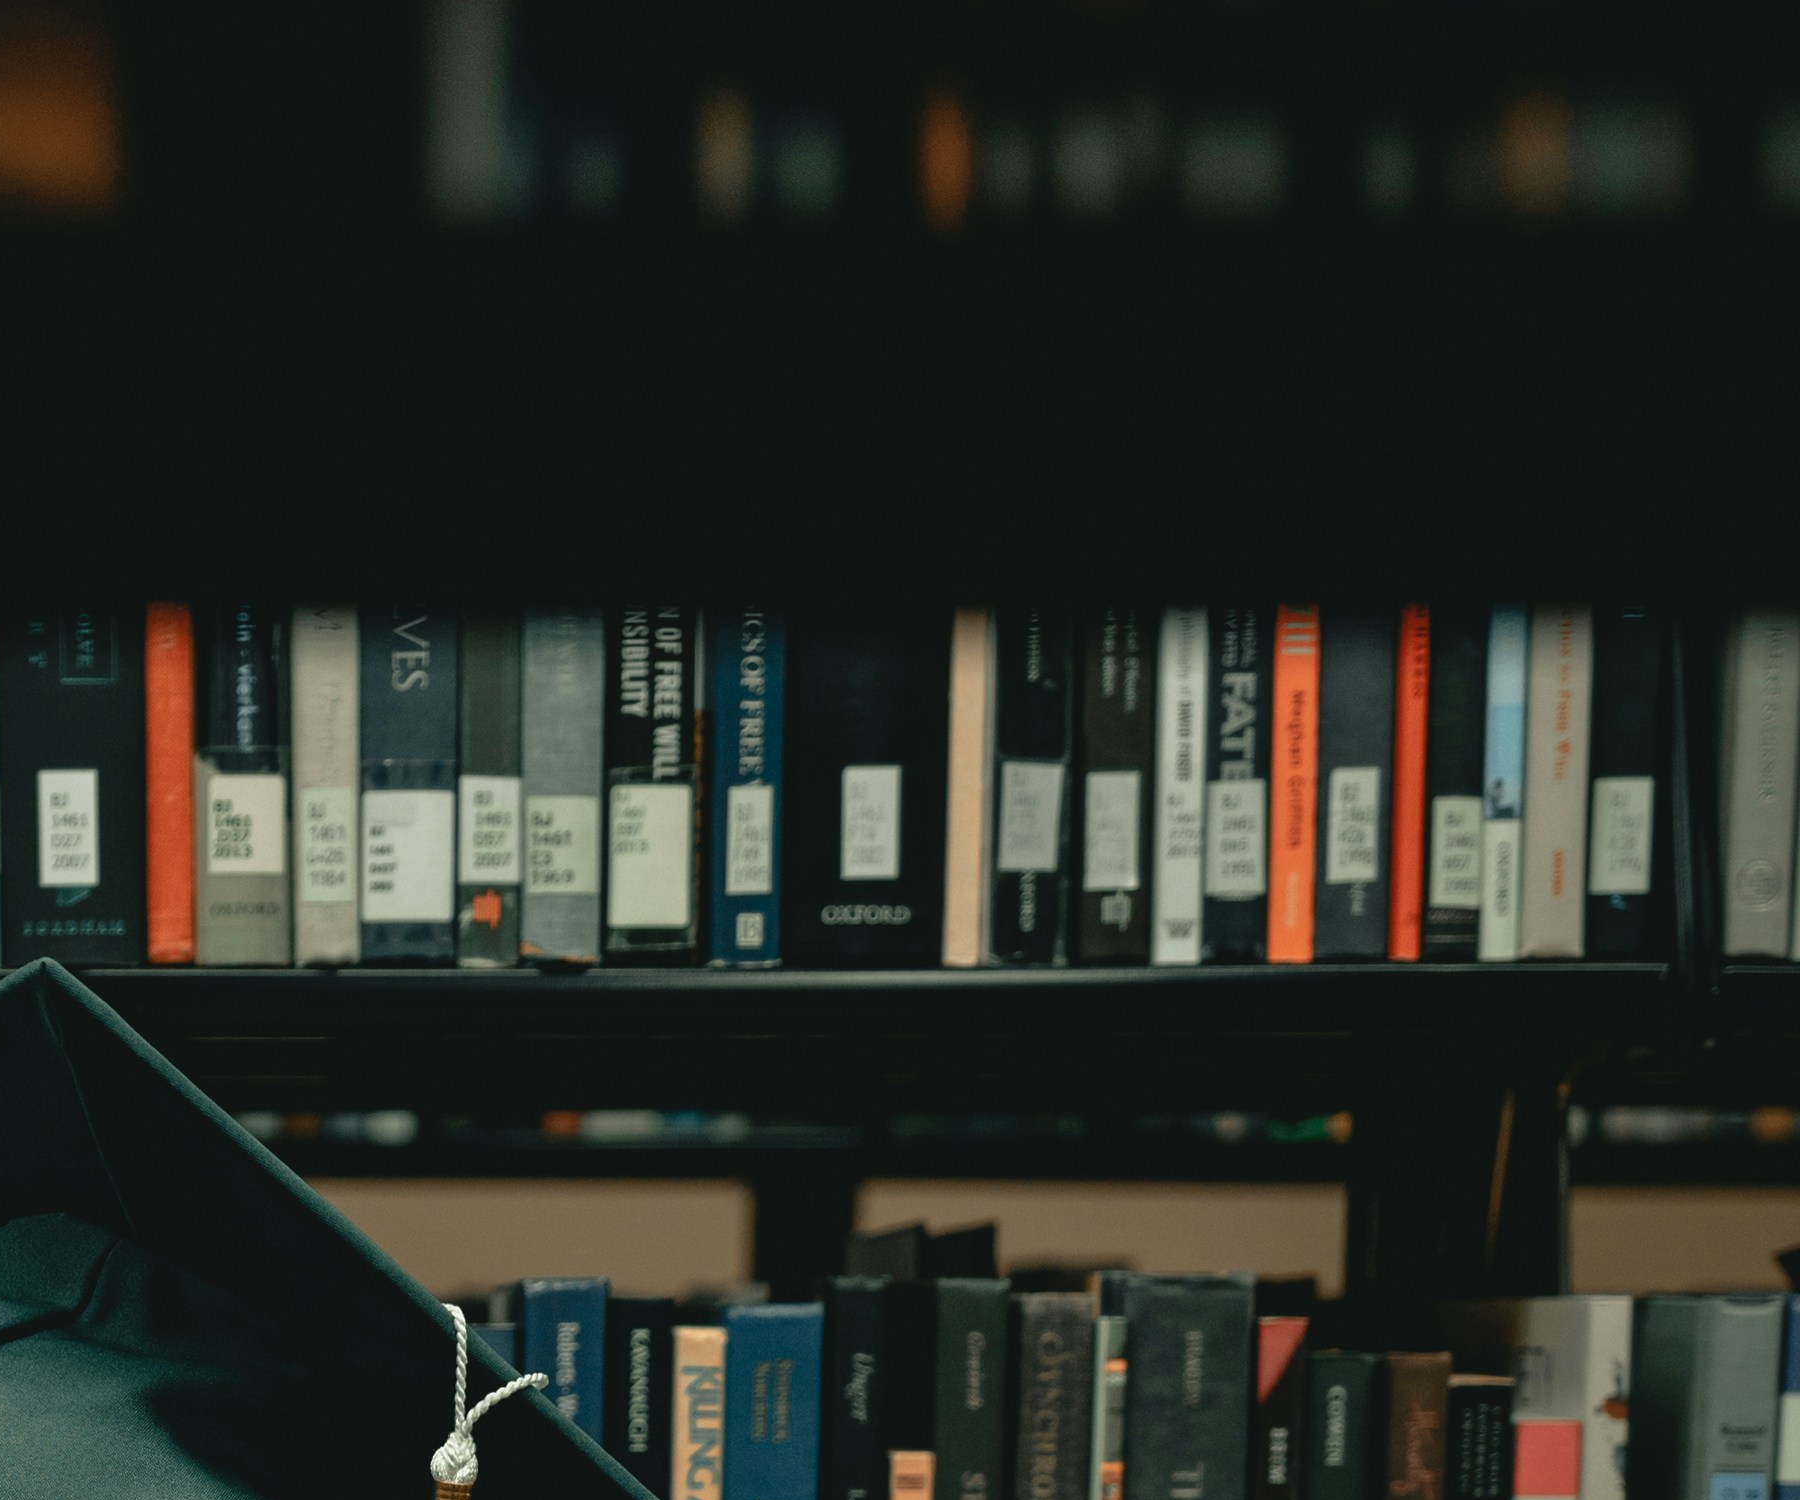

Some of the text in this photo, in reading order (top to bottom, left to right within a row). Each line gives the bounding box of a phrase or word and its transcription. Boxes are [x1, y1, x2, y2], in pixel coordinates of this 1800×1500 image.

[652, 627, 681, 781] OF FREE WILL
[737, 655, 767, 778] OF FREE
[1218, 671, 1259, 781] FATE
[1287, 689, 1307, 770] Meghan
[51, 810, 88, 828] 1461
[213, 813, 253, 829] 1461
[309, 824, 345, 842] 1461
[474, 811, 513, 828] 1461
[51, 851, 89, 870] 2007
[213, 843, 254, 858] 2013
[472, 851, 514, 869] 2007
[208, 902, 280, 918] OXFORD
[819, 903, 913, 926] OXFORD
[555, 1321, 582, 1387] Roberts
[628, 1327, 651, 1453] KAVANAUGH
[842, 1352, 875, 1425] Unger
[676, 1364, 724, 1490] KILLING
[1323, 1384, 1348, 1467] COWEN
